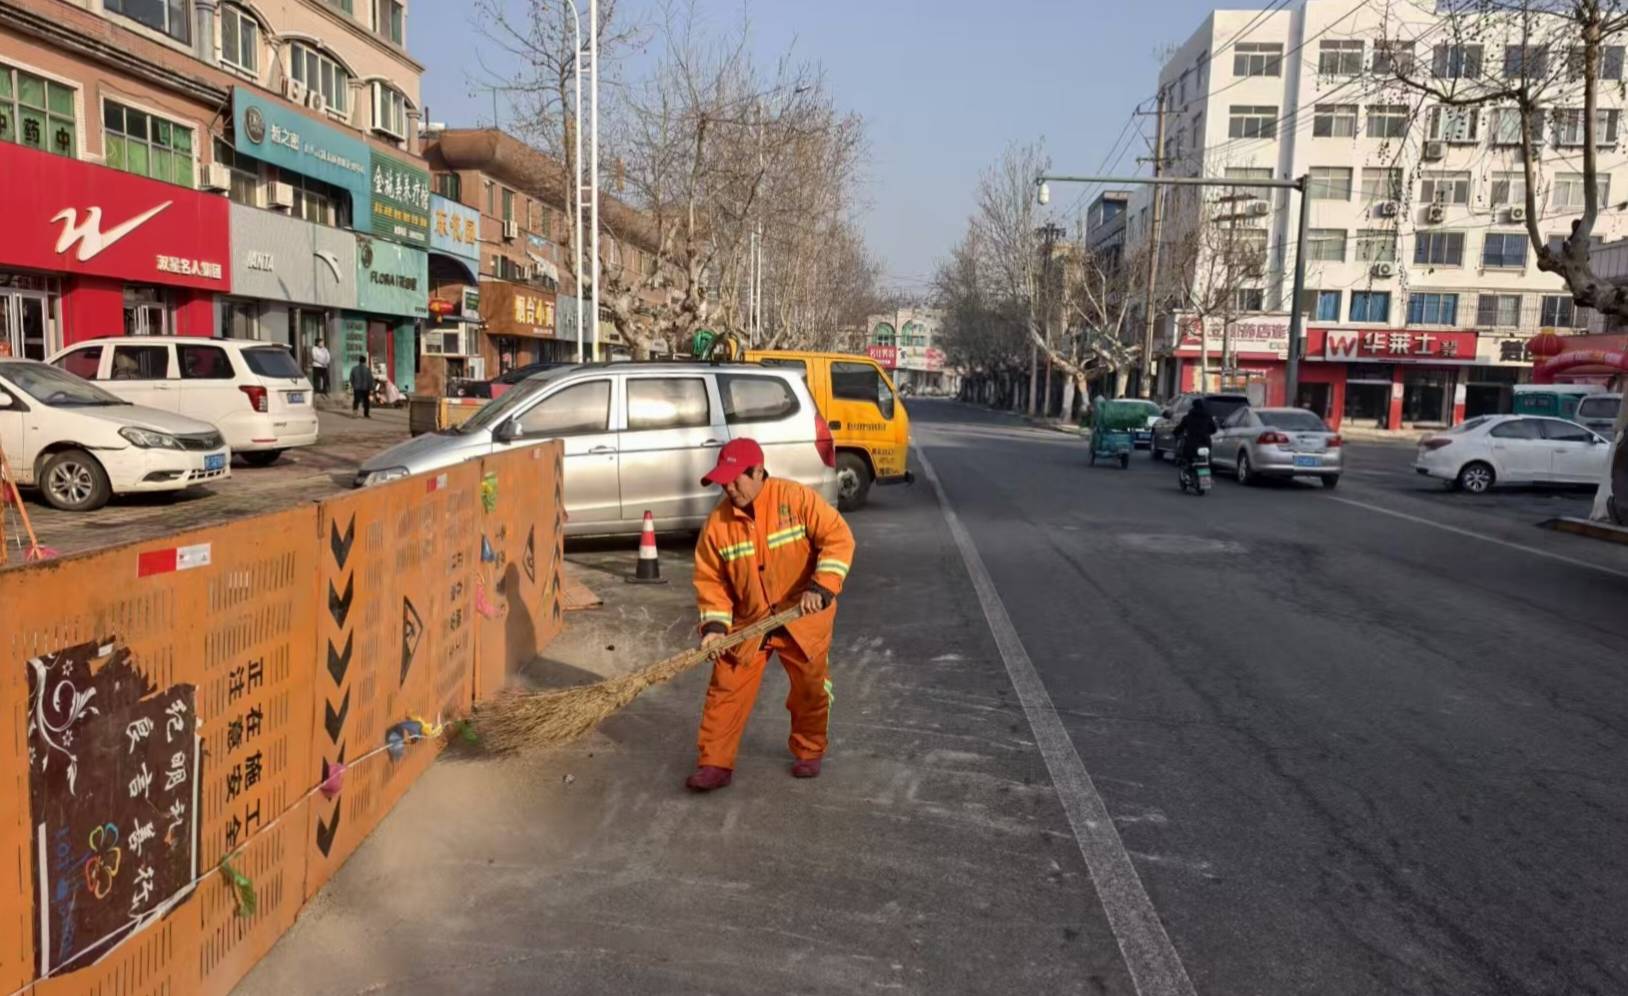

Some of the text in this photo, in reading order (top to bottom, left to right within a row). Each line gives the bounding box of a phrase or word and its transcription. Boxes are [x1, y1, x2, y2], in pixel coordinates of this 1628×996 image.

[1364, 332, 1437, 355] 华莱士
[126, 716, 156, 910] 良言善行
[226, 665, 245, 852] 注意安全
[246, 656, 264, 837] 正在施工
